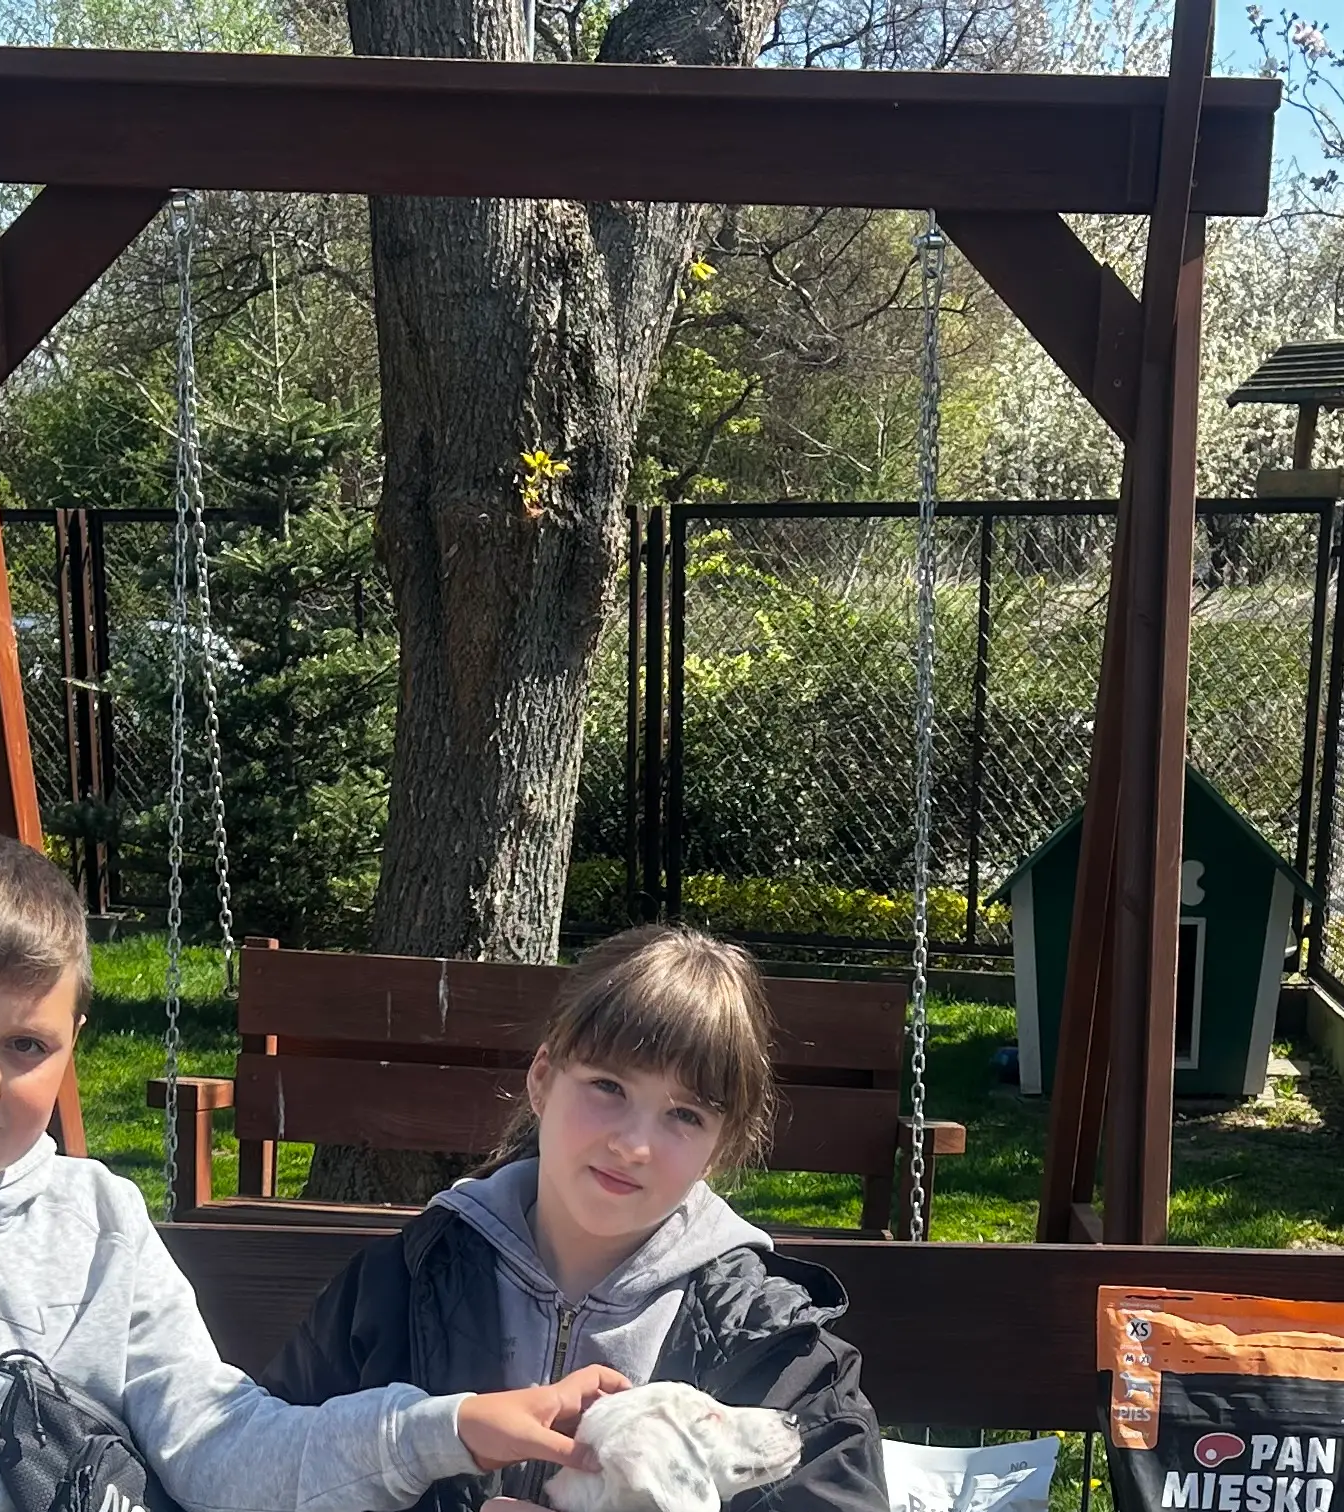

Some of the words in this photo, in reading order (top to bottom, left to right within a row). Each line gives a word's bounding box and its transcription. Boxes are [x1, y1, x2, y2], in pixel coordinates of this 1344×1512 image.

[1130, 1323, 1149, 1337] XS
[1118, 1406, 1152, 1421] PIES
[1250, 1434, 1336, 1474] PAN
